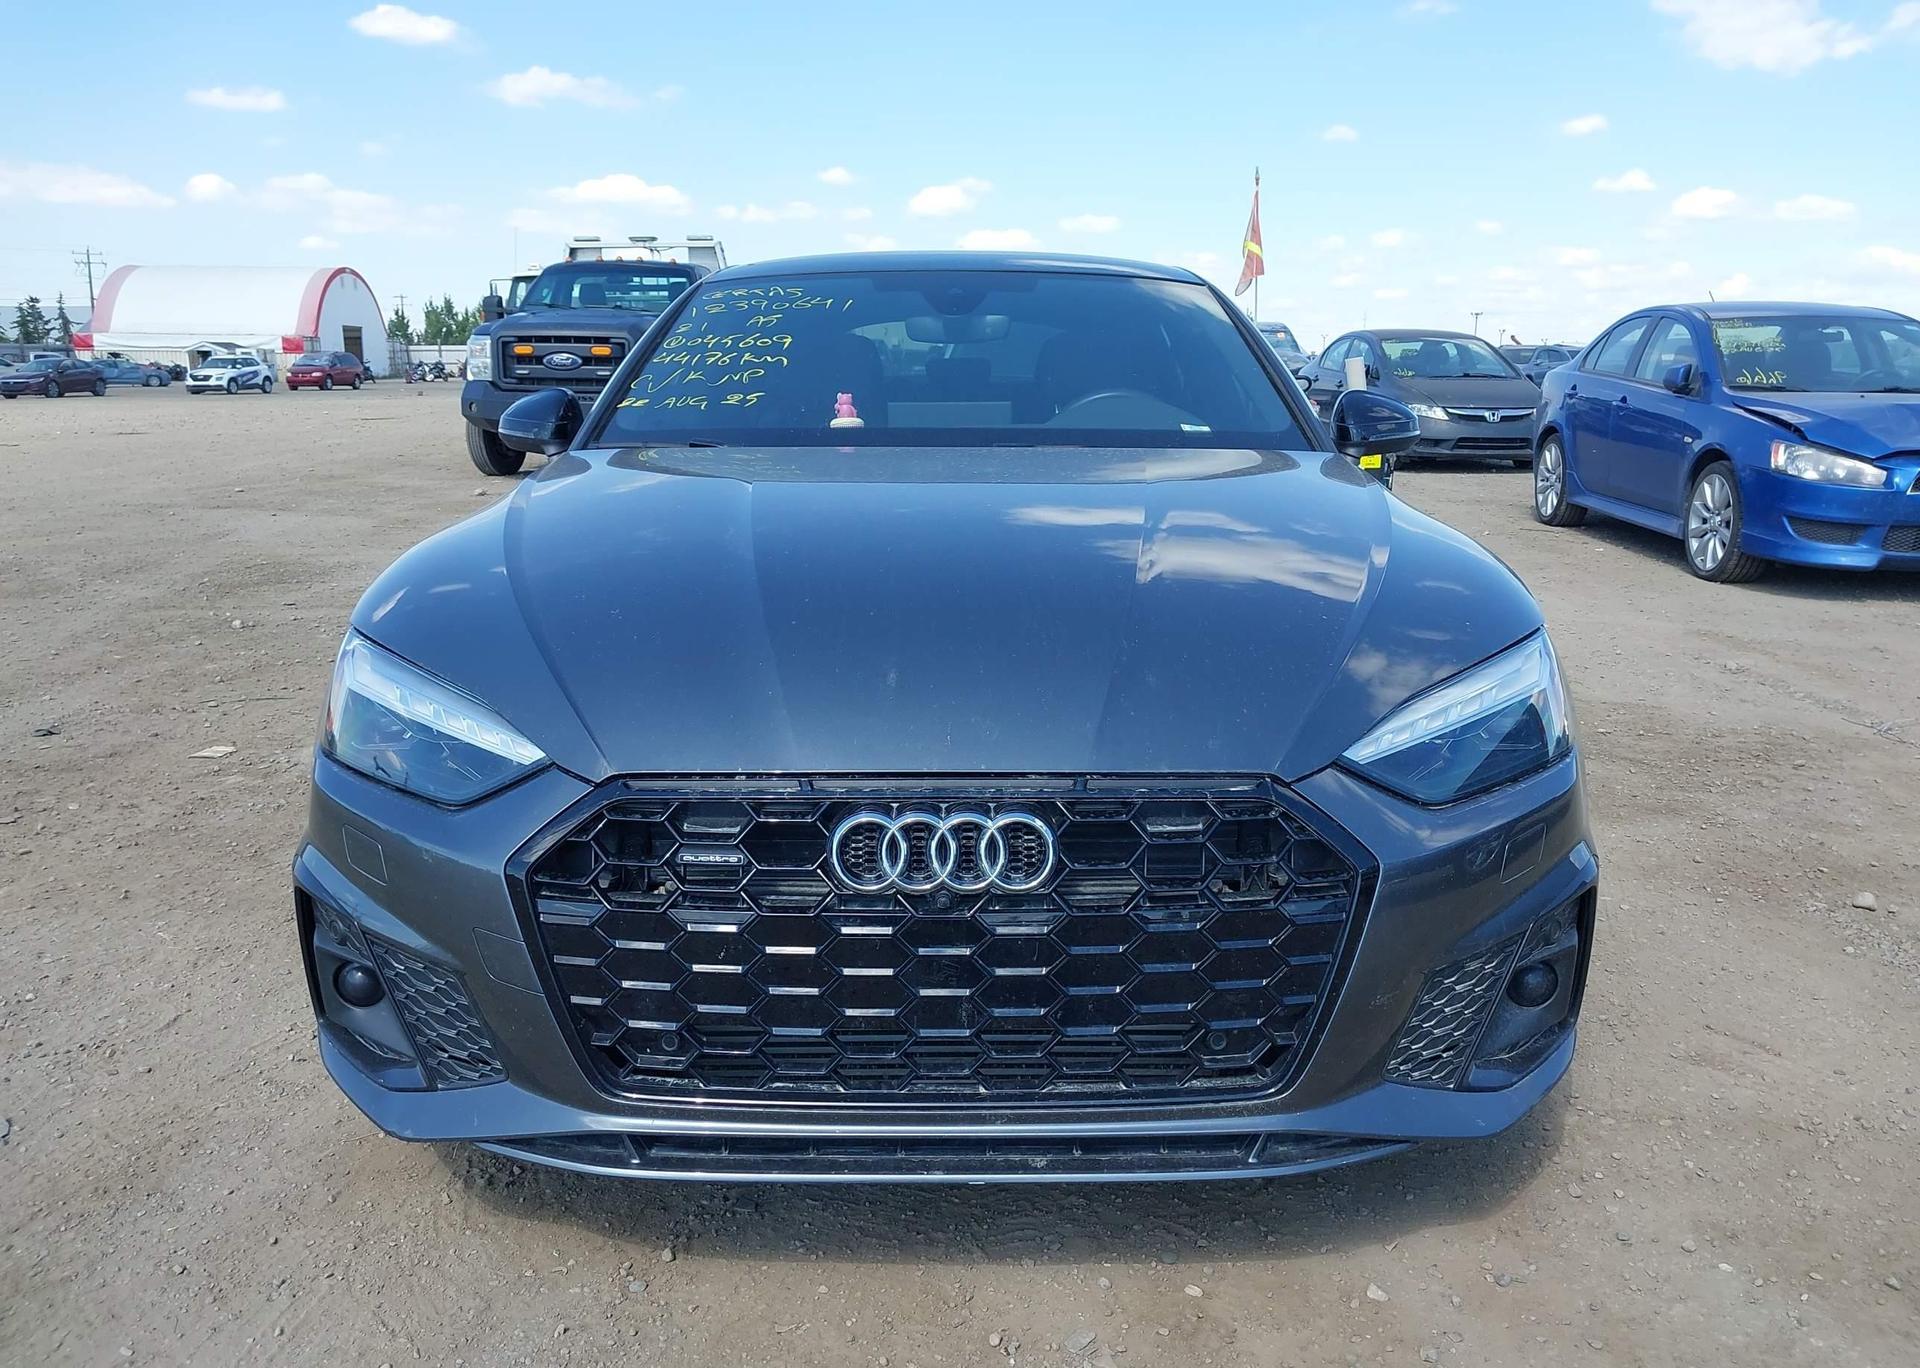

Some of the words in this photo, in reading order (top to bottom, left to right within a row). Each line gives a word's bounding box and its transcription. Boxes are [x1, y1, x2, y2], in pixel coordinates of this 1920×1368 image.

[692, 296, 853, 318] 12390641
[654, 395, 708, 411] AUG
[720, 392, 766, 407] 25
[683, 855, 738, 863] quattro
